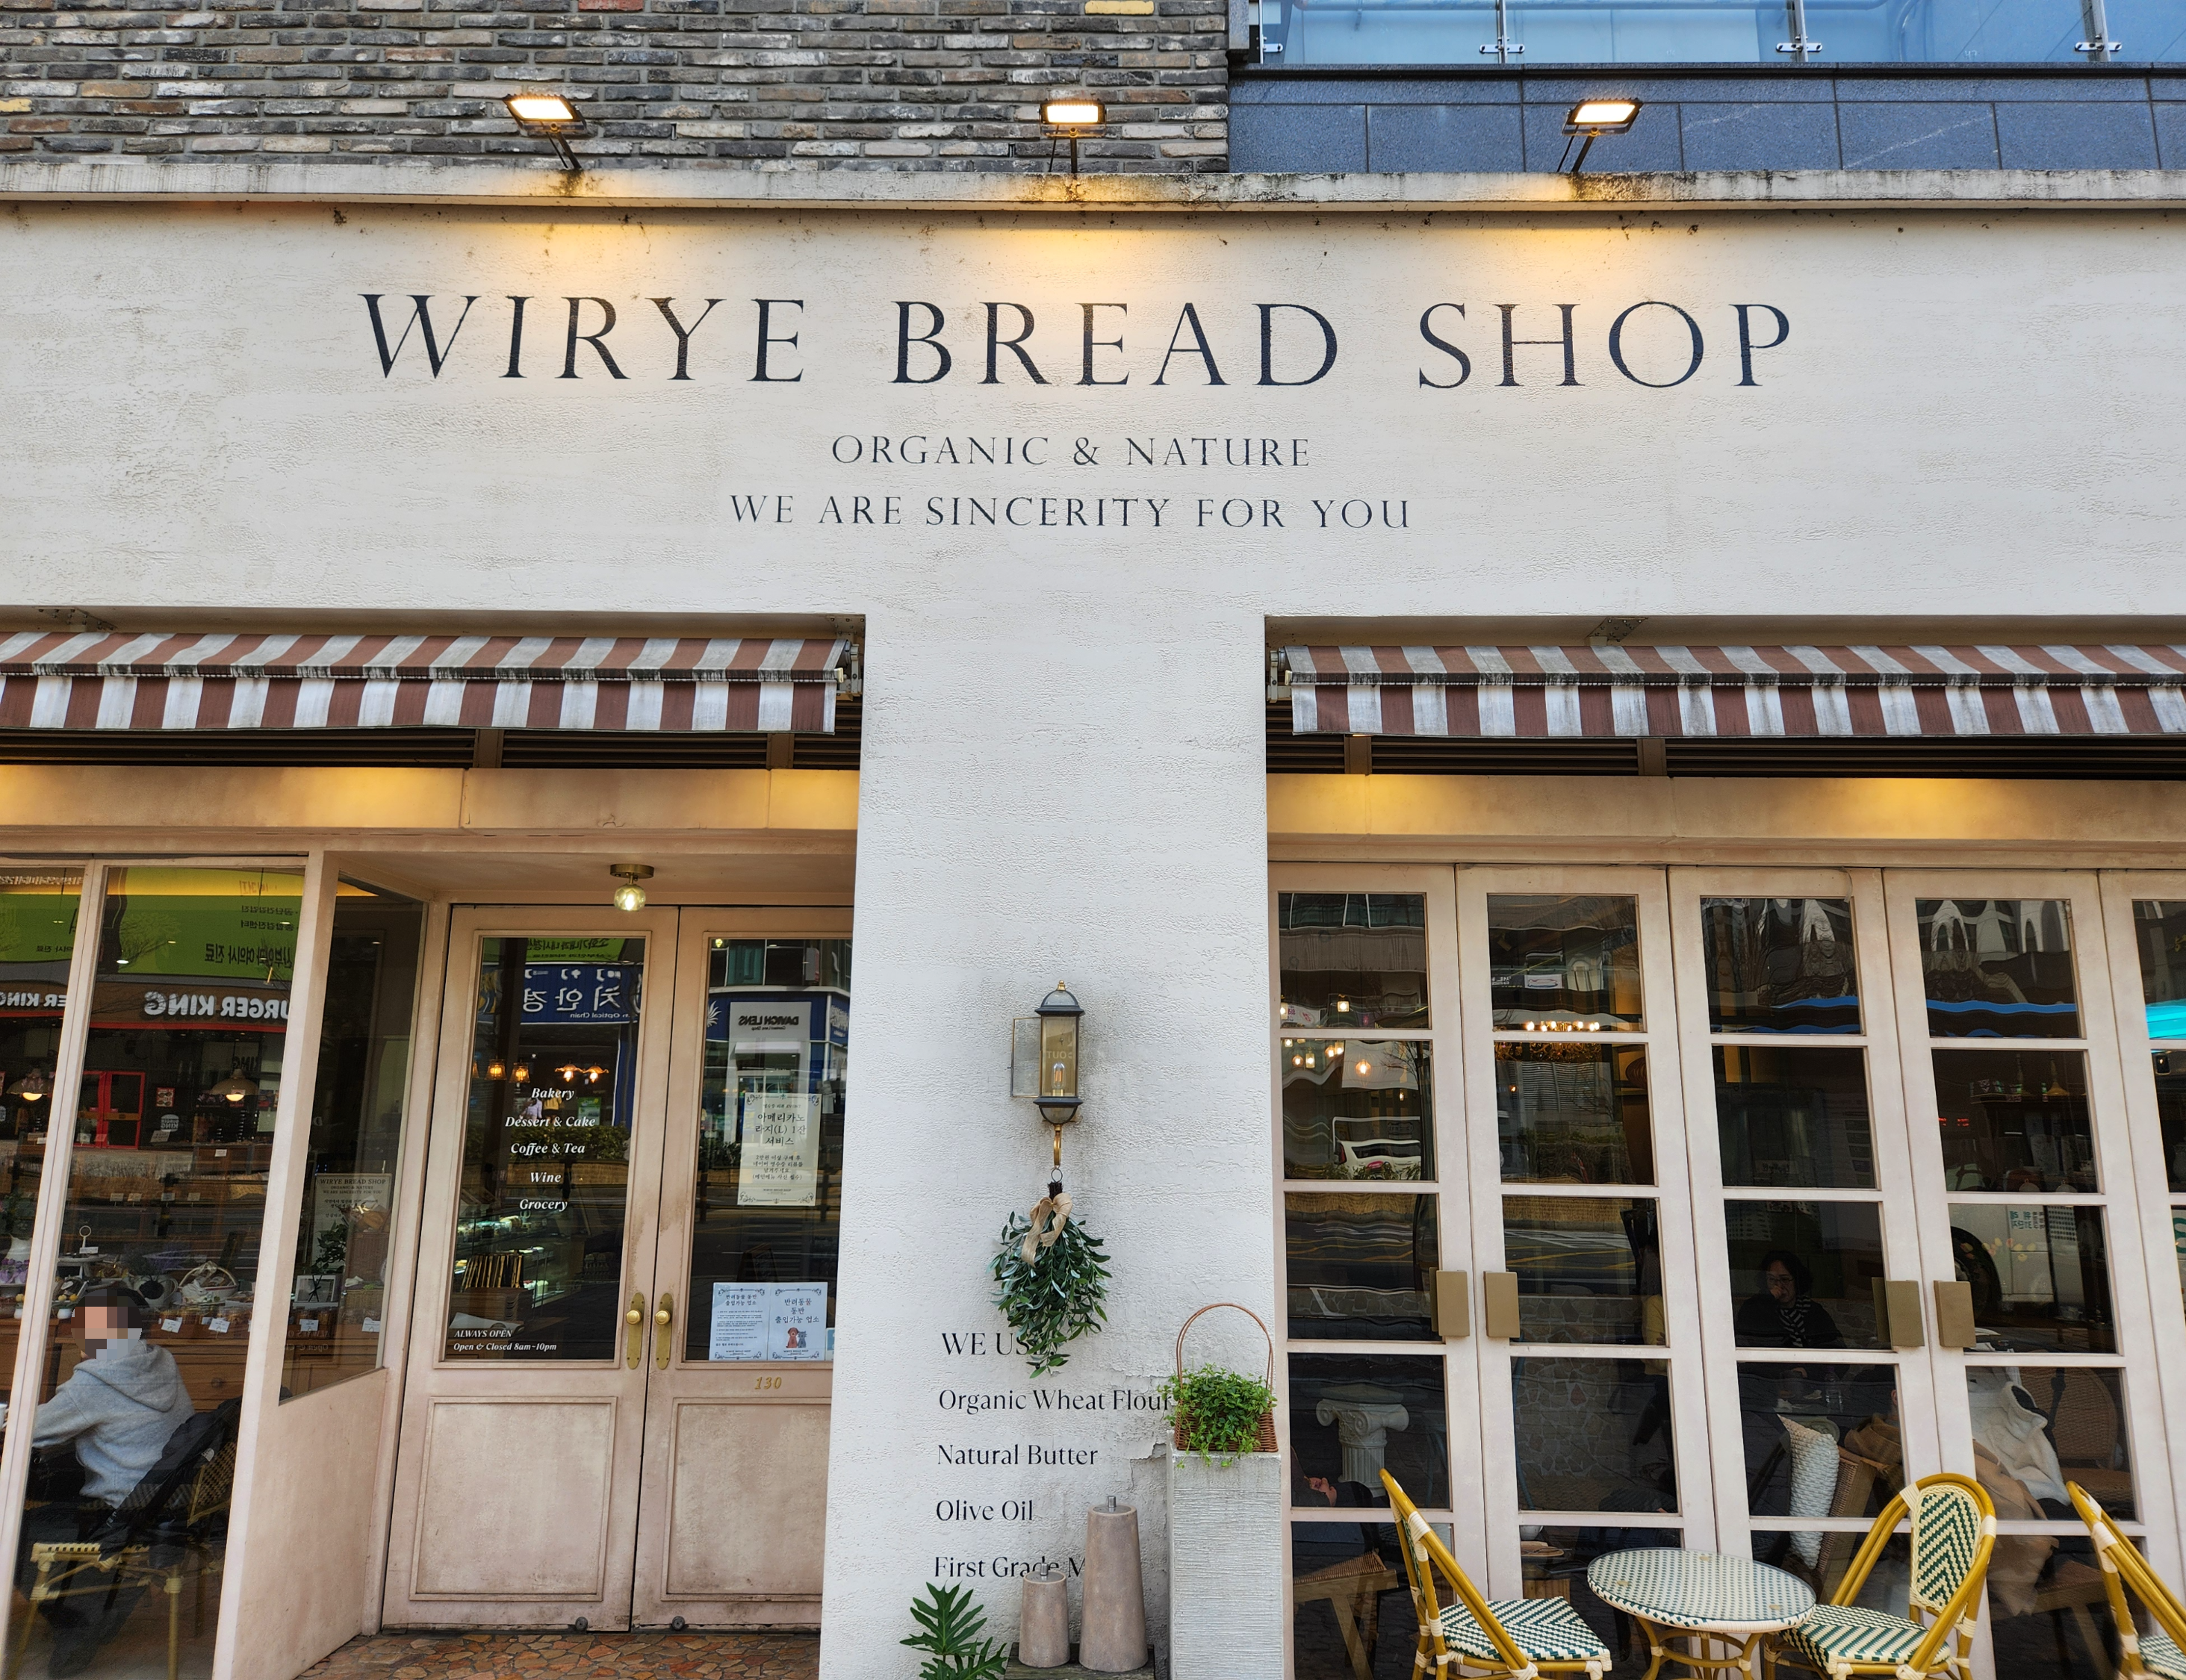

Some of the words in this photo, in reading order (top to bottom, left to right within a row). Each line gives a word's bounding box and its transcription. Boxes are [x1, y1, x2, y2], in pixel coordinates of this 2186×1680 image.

[358, 294, 804, 382] WIRYE
[888, 302, 1338, 386] BREAD
[1419, 301, 1789, 388] SHOP
[833, 435, 1047, 465] ORGANIC
[1073, 438, 1100, 466] &
[1125, 438, 1310, 466] NATURE
[731, 496, 793, 523] WE
[819, 497, 901, 525] ARE
[927, 497, 1170, 527] SINCERITY
[1196, 499, 1285, 527] FOR
[1311, 500, 1410, 529] YOU
[531, 1087, 575, 1101] Bakery
[505, 1116, 550, 1127] Dessert
[553, 1116, 562, 1127] &
[565, 1116, 597, 1127] Cake
[757, 1113, 806, 1123] 아메리카노
[765, 1136, 795, 1147] 서비스
[511, 1142, 548, 1157] Coffee
[551, 1142, 561, 1154] &
[564, 1142, 586, 1154] Tea
[530, 1172, 562, 1183] Wine
[519, 1199, 568, 1212] Grocery
[784, 1298, 813, 1307] 반려동물
[790, 1307, 805, 1315] 동반
[774, 1316, 804, 1324] 출입가능
[806, 1316, 820, 1324] 업소
[454, 1330, 488, 1338] ALWAYS
[489, 1330, 512, 1338] OPEN
[453, 1343, 474, 1352] Open
[485, 1343, 512, 1351] Closed
[513, 1343, 557, 1352] 8am~10pm
[942, 1333, 986, 1355] WE
[754, 1376, 782, 1390] 130
[940, 1390, 1026, 1415] Organic
[1033, 1390, 1105, 1410] Wheat
[1113, 1390, 1172, 1410] Flour
[938, 1444, 1019, 1465] Natural
[1028, 1445, 1099, 1466] Butter
[937, 1500, 994, 1522] Olive
[1002, 1500, 1033, 1521] Oil
[935, 1556, 986, 1577] First
